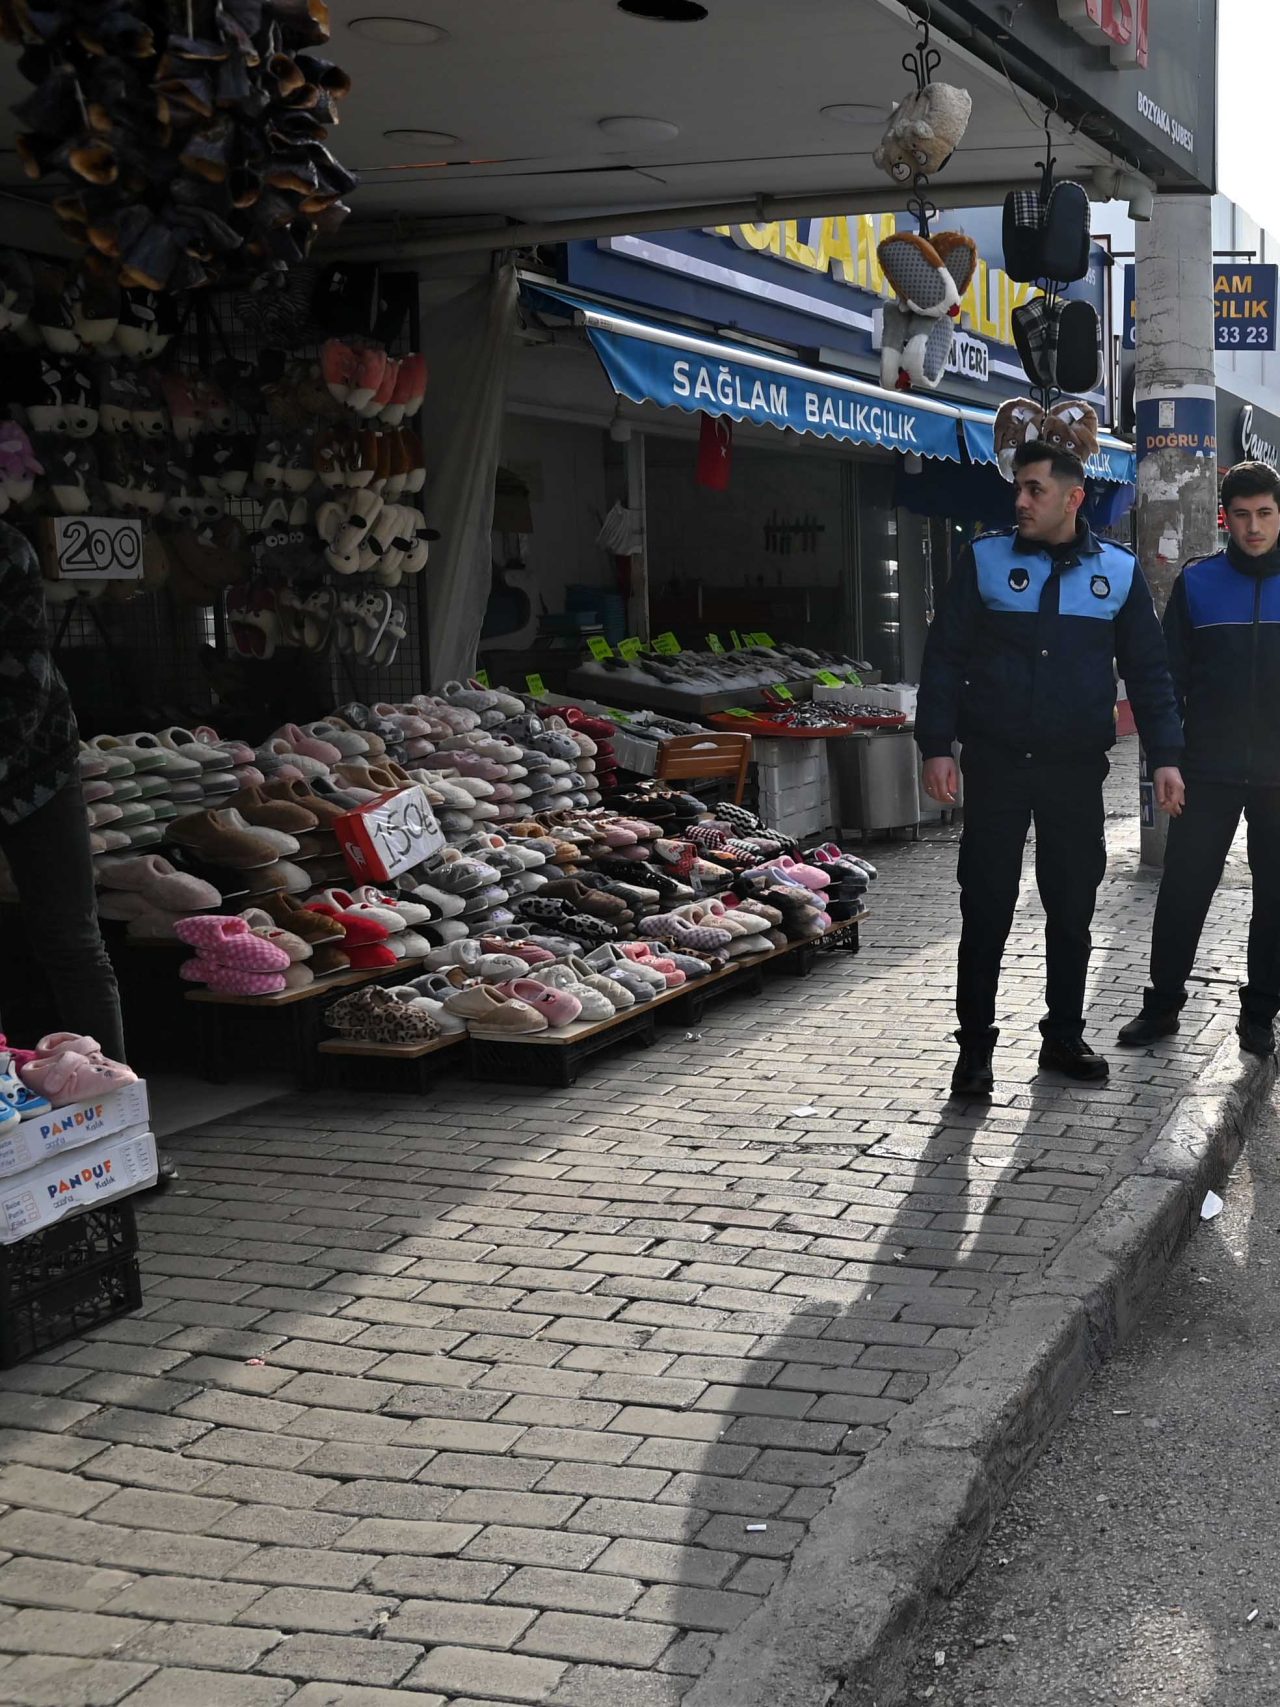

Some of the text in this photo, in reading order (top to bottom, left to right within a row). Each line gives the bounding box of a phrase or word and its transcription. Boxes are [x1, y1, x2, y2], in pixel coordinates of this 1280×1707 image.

[1137, 91, 1194, 153] BOZYAKA ŞUBESİ
[1219, 326, 1268, 343] 33 23
[673, 360, 917, 443] SAĞLAM BALIKÇILIK
[1146, 432, 1217, 449] DOĞRU AD
[60, 521, 142, 572] 200
[40, 1104, 105, 1139] PANDUF
[47, 1159, 112, 1198] PANDUF
